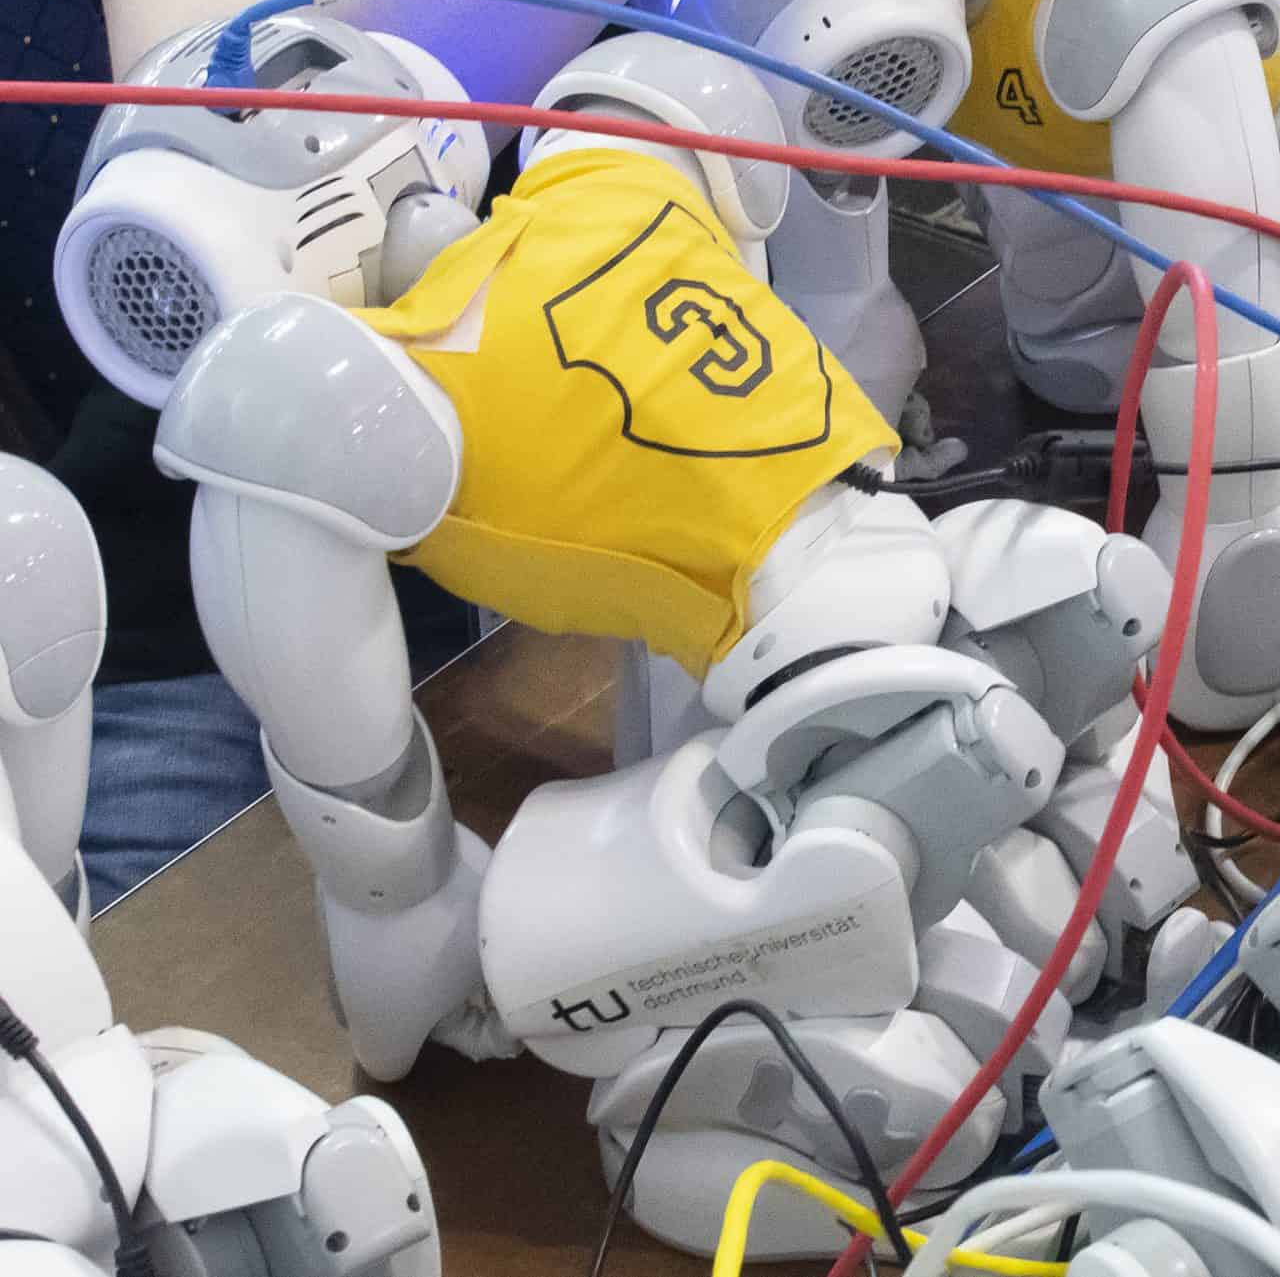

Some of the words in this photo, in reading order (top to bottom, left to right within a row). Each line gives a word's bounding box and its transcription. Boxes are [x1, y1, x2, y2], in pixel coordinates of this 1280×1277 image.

[997, 68, 1043, 126] 4
[645, 279, 773, 398] 3
[627, 951, 746, 993] technische
[751, 915, 861, 965] universität
[643, 970, 747, 1010] dortmund
